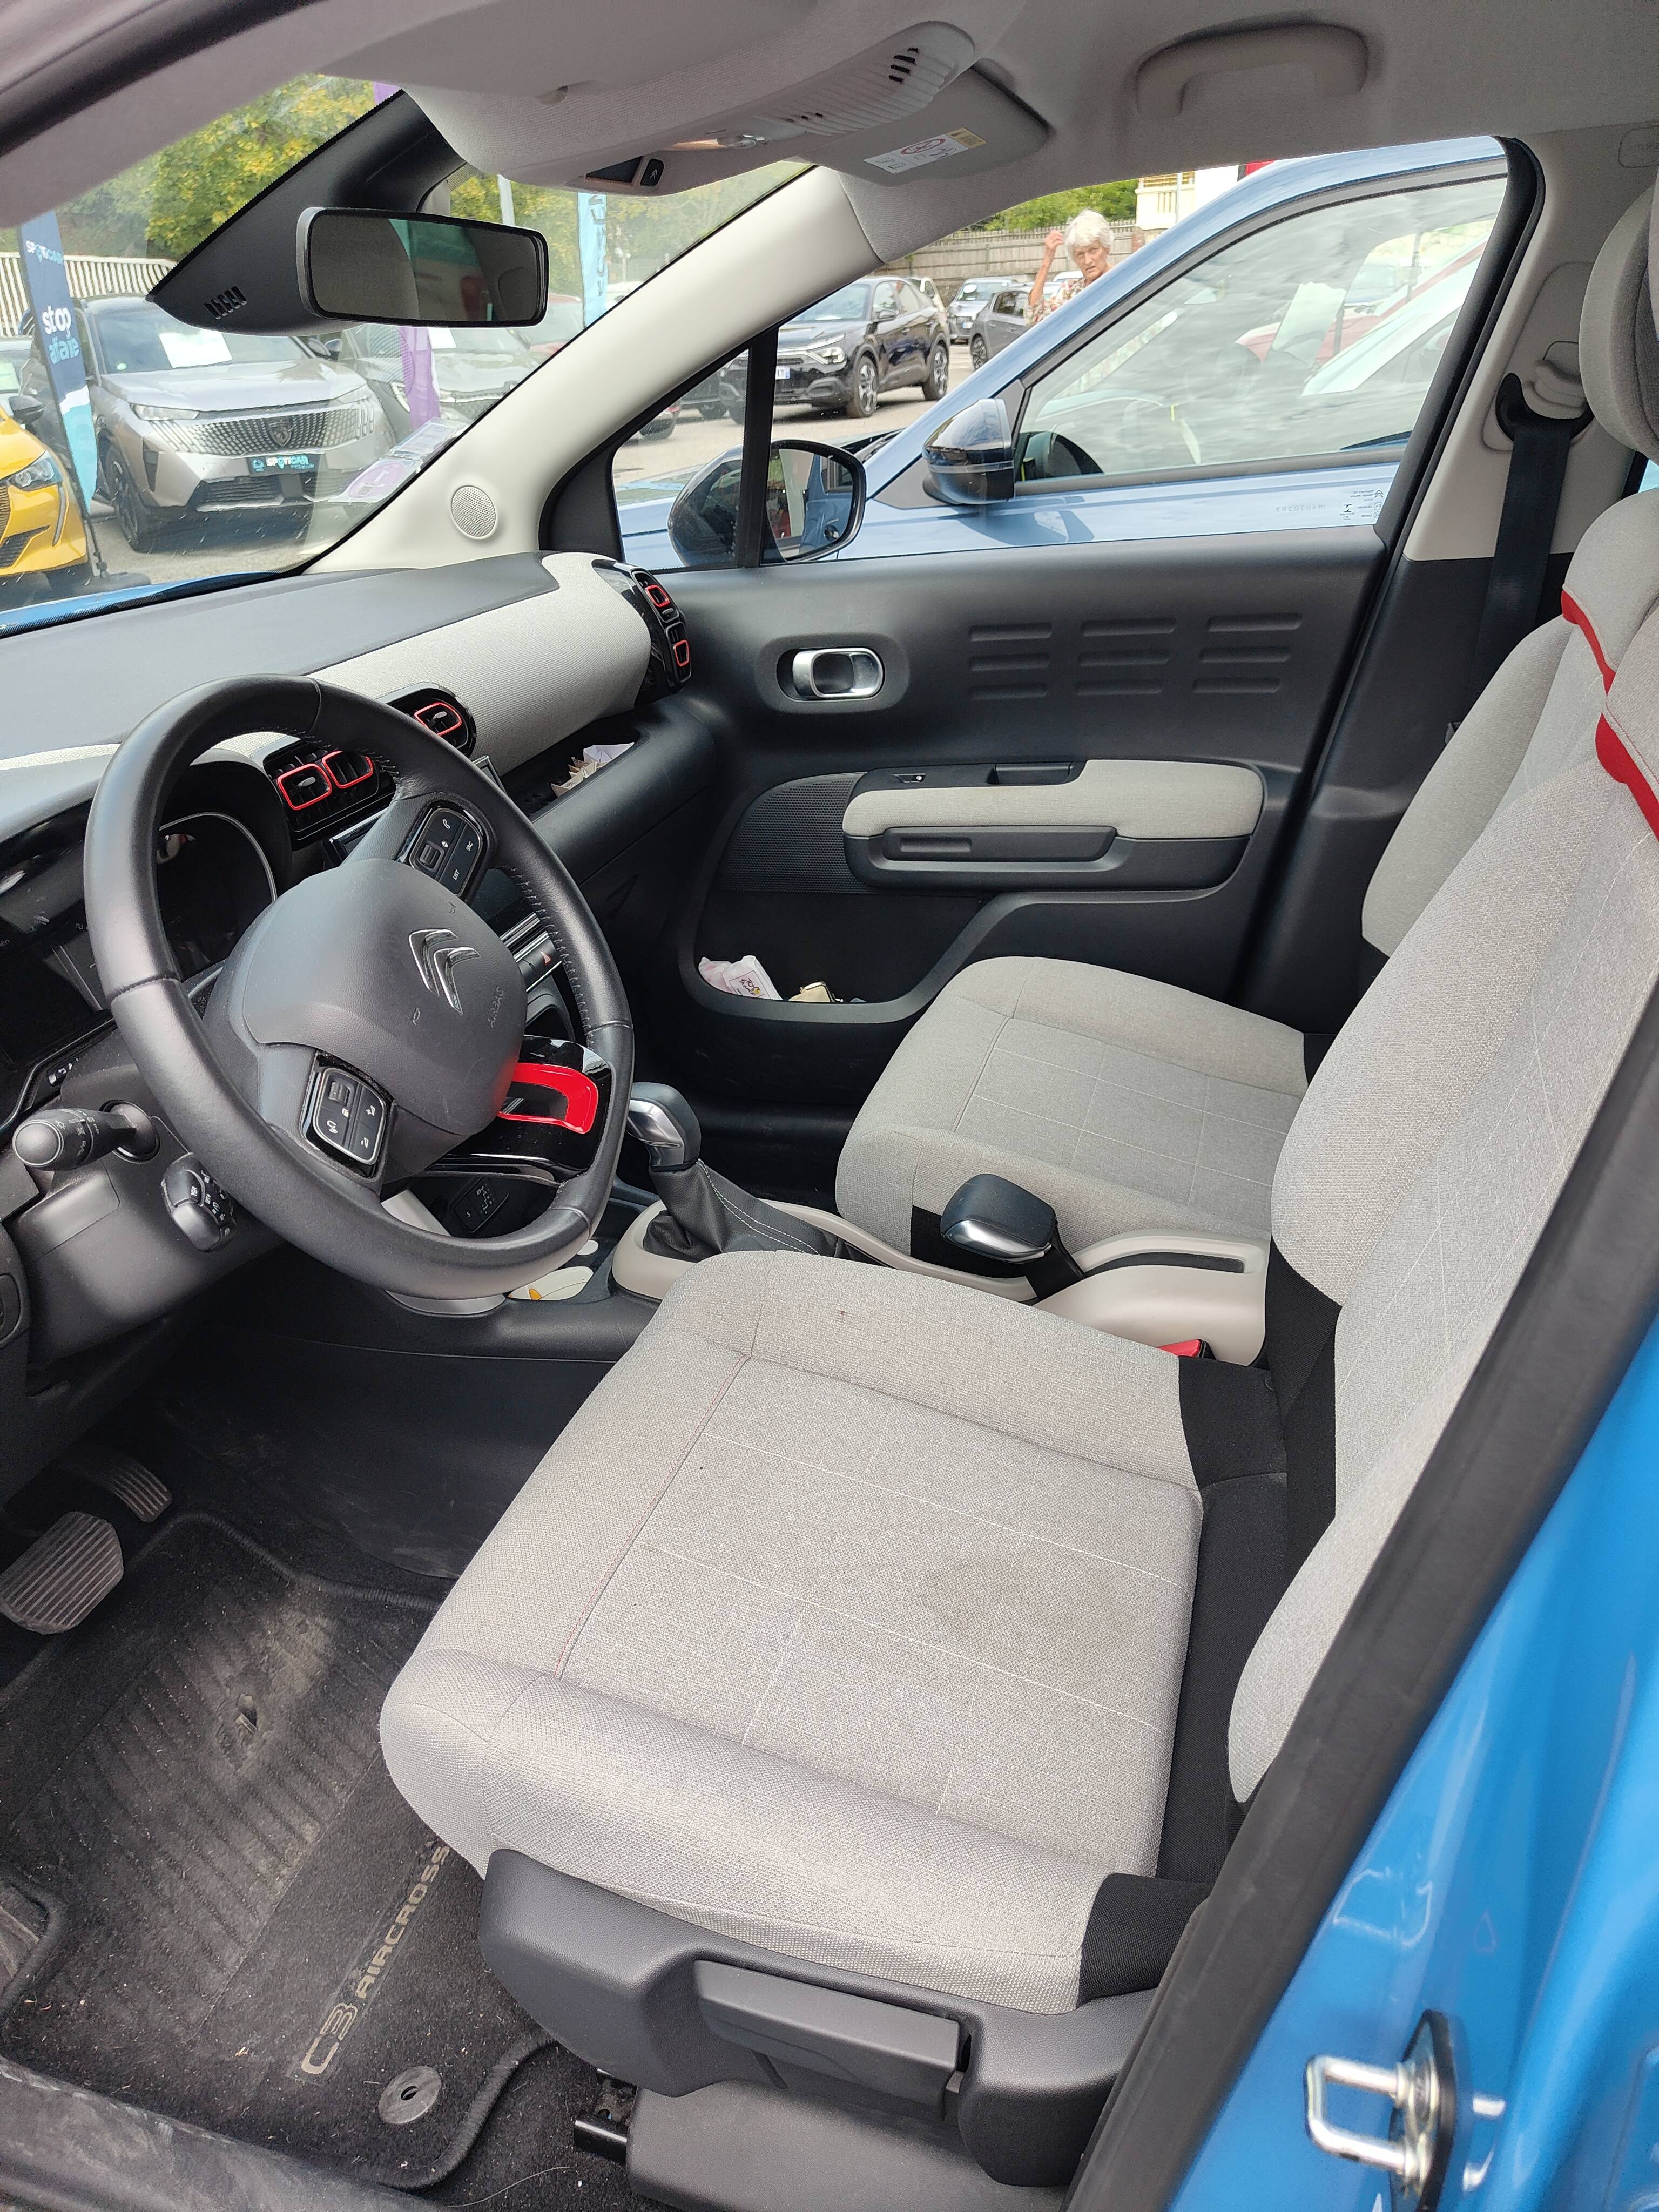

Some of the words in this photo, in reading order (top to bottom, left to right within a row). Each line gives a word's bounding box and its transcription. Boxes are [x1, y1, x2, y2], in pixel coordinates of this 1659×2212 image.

[42, 305, 72, 339] stop
[301, 2002, 358, 2074] C3
[355, 1845, 450, 1999] AIRCROSS
